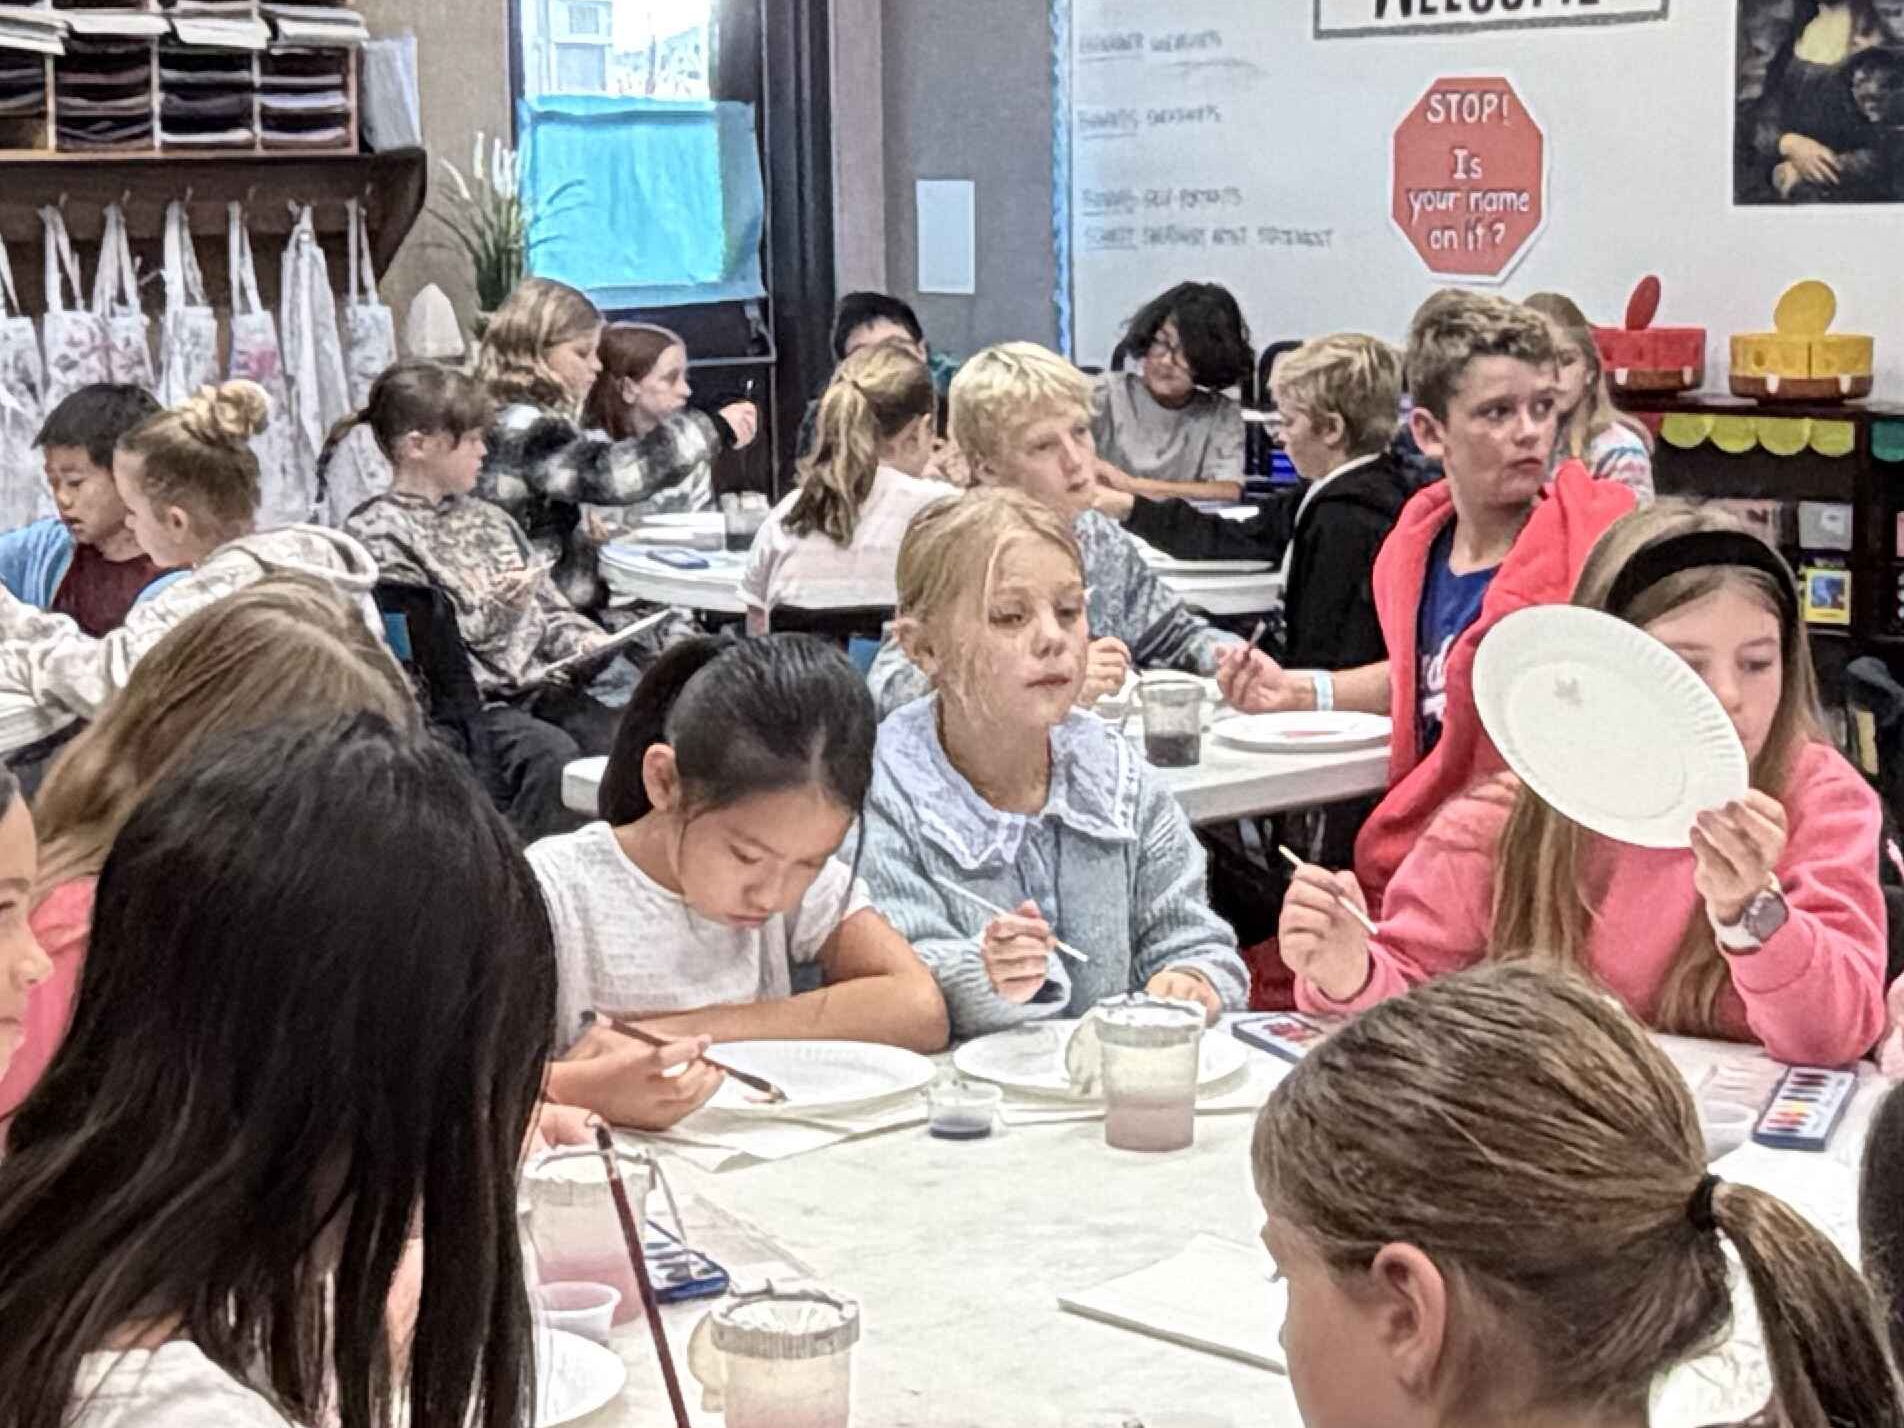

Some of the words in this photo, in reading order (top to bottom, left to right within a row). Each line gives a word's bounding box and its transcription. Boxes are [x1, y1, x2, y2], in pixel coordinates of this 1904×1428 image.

[1425, 91, 1512, 126] STOP!
[1452, 148, 1483, 180] Is
[1408, 190, 1461, 224] your
[1469, 189, 1530, 214] name
[1430, 227, 1458, 251] on
